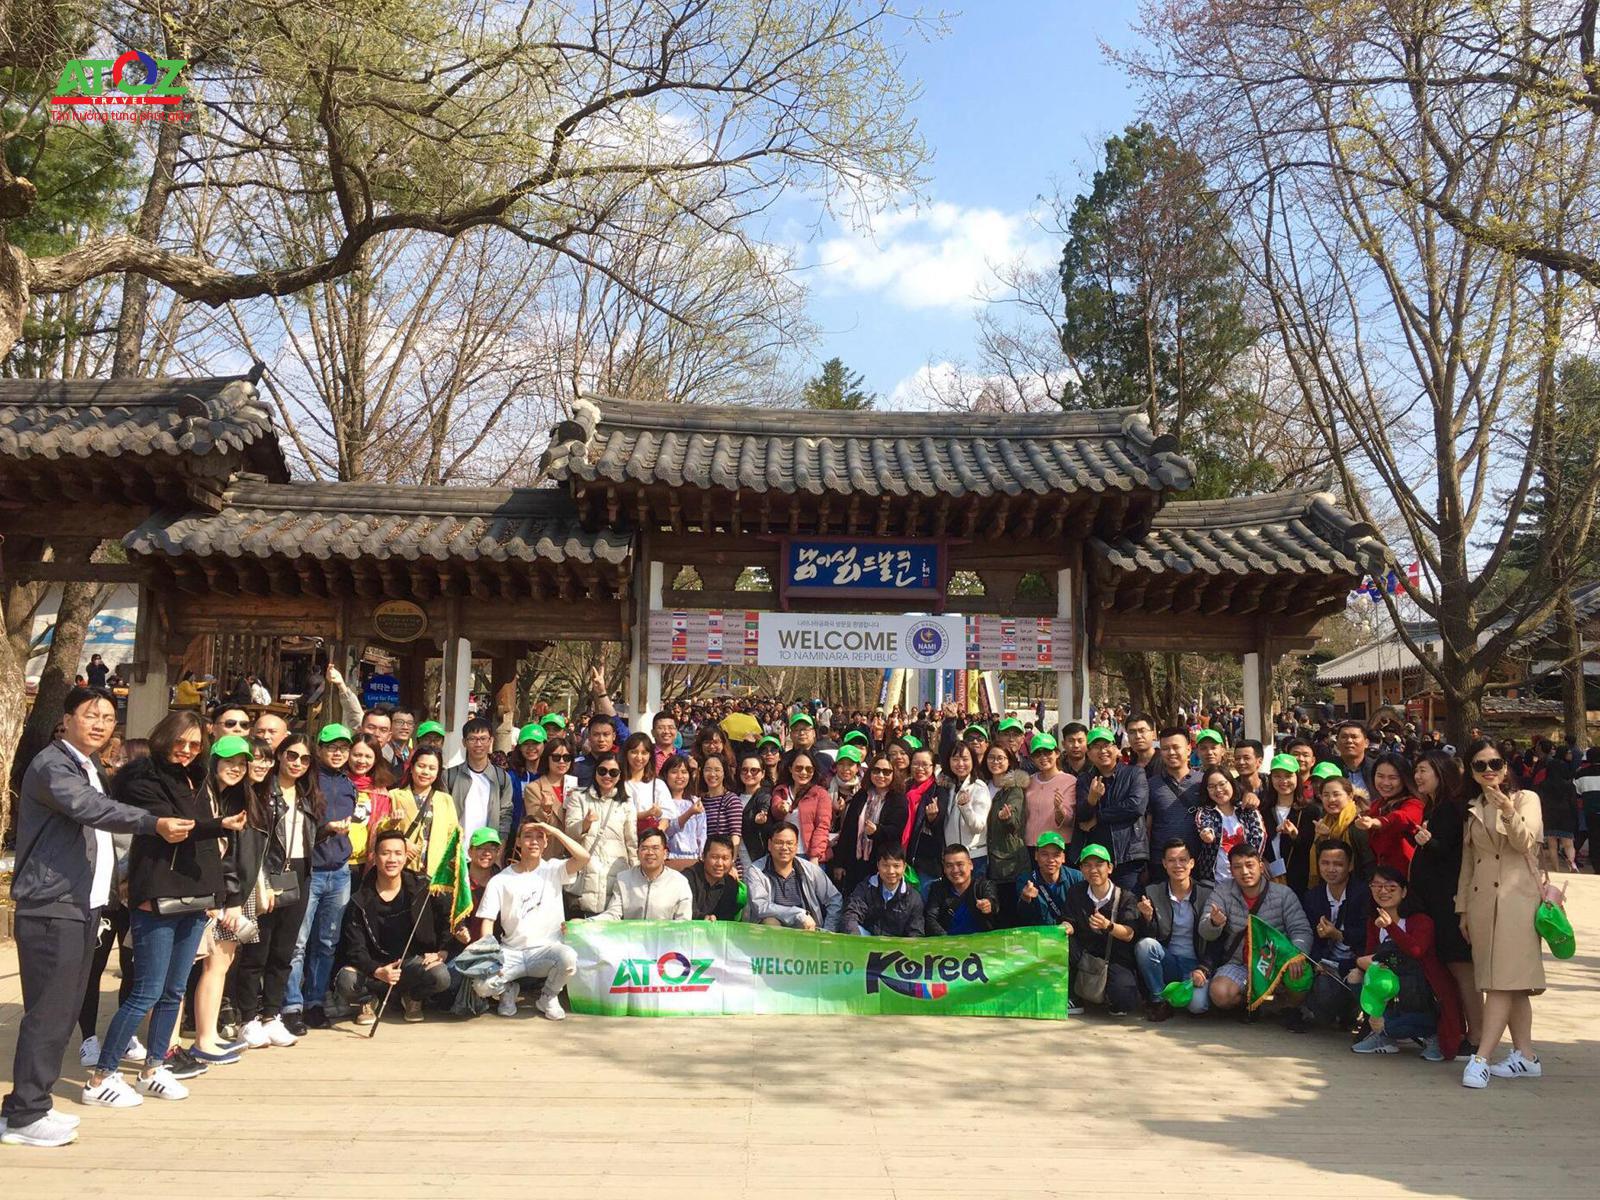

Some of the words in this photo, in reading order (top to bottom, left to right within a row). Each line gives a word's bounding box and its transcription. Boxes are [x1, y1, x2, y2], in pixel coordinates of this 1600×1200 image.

[778, 630, 898, 651] WELCOME
[779, 650, 791, 660] TO
[793, 650, 849, 661] NAMINARA
[852, 652, 897, 662] REPUBLIC
[611, 951, 716, 986] ATOZ
[751, 956, 829, 975] WELCOME
[833, 960, 854, 975] TO
[866, 950, 989, 995] Korea
